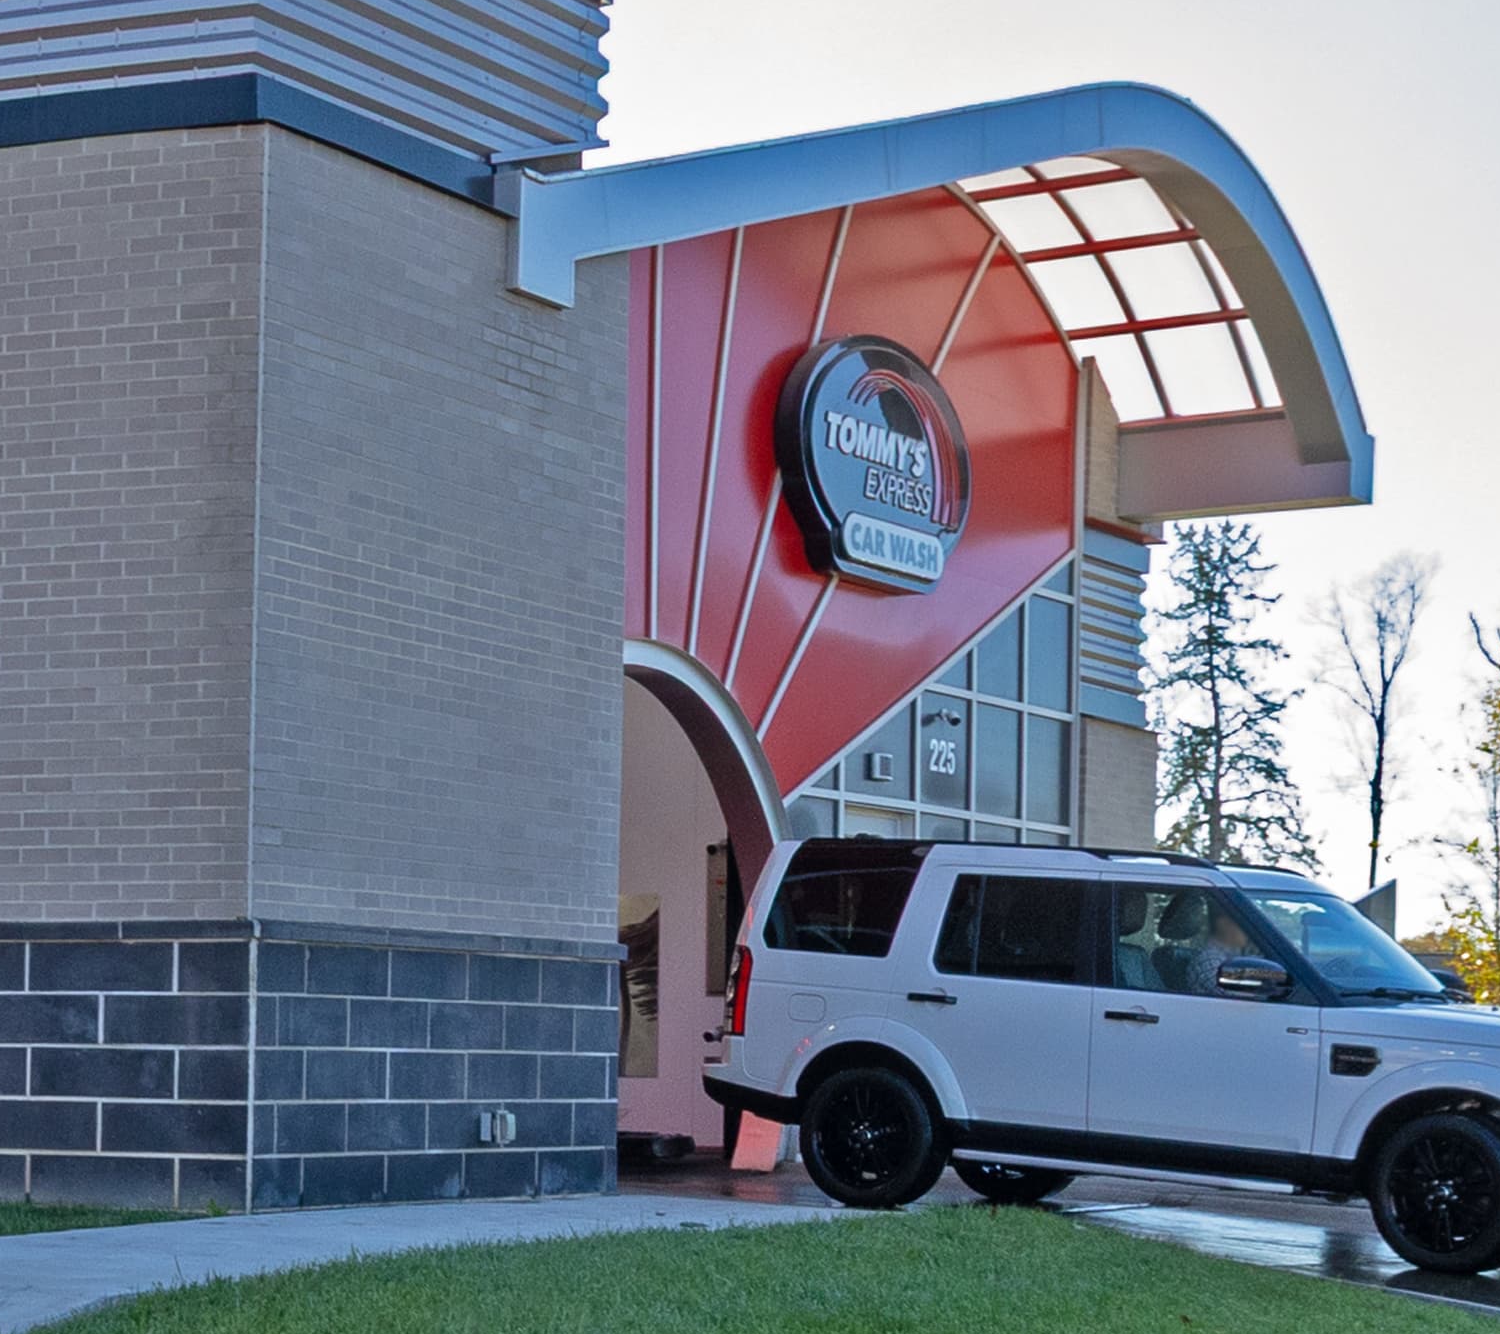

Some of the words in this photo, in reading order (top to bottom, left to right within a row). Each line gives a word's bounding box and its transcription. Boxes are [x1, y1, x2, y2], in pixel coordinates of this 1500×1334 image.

[826, 411, 929, 477] TOMMY'S
[865, 467, 932, 516] EXPRESS
[851, 523, 886, 558] CAR
[890, 533, 938, 572] WASH
[930, 738, 956, 775] 225
